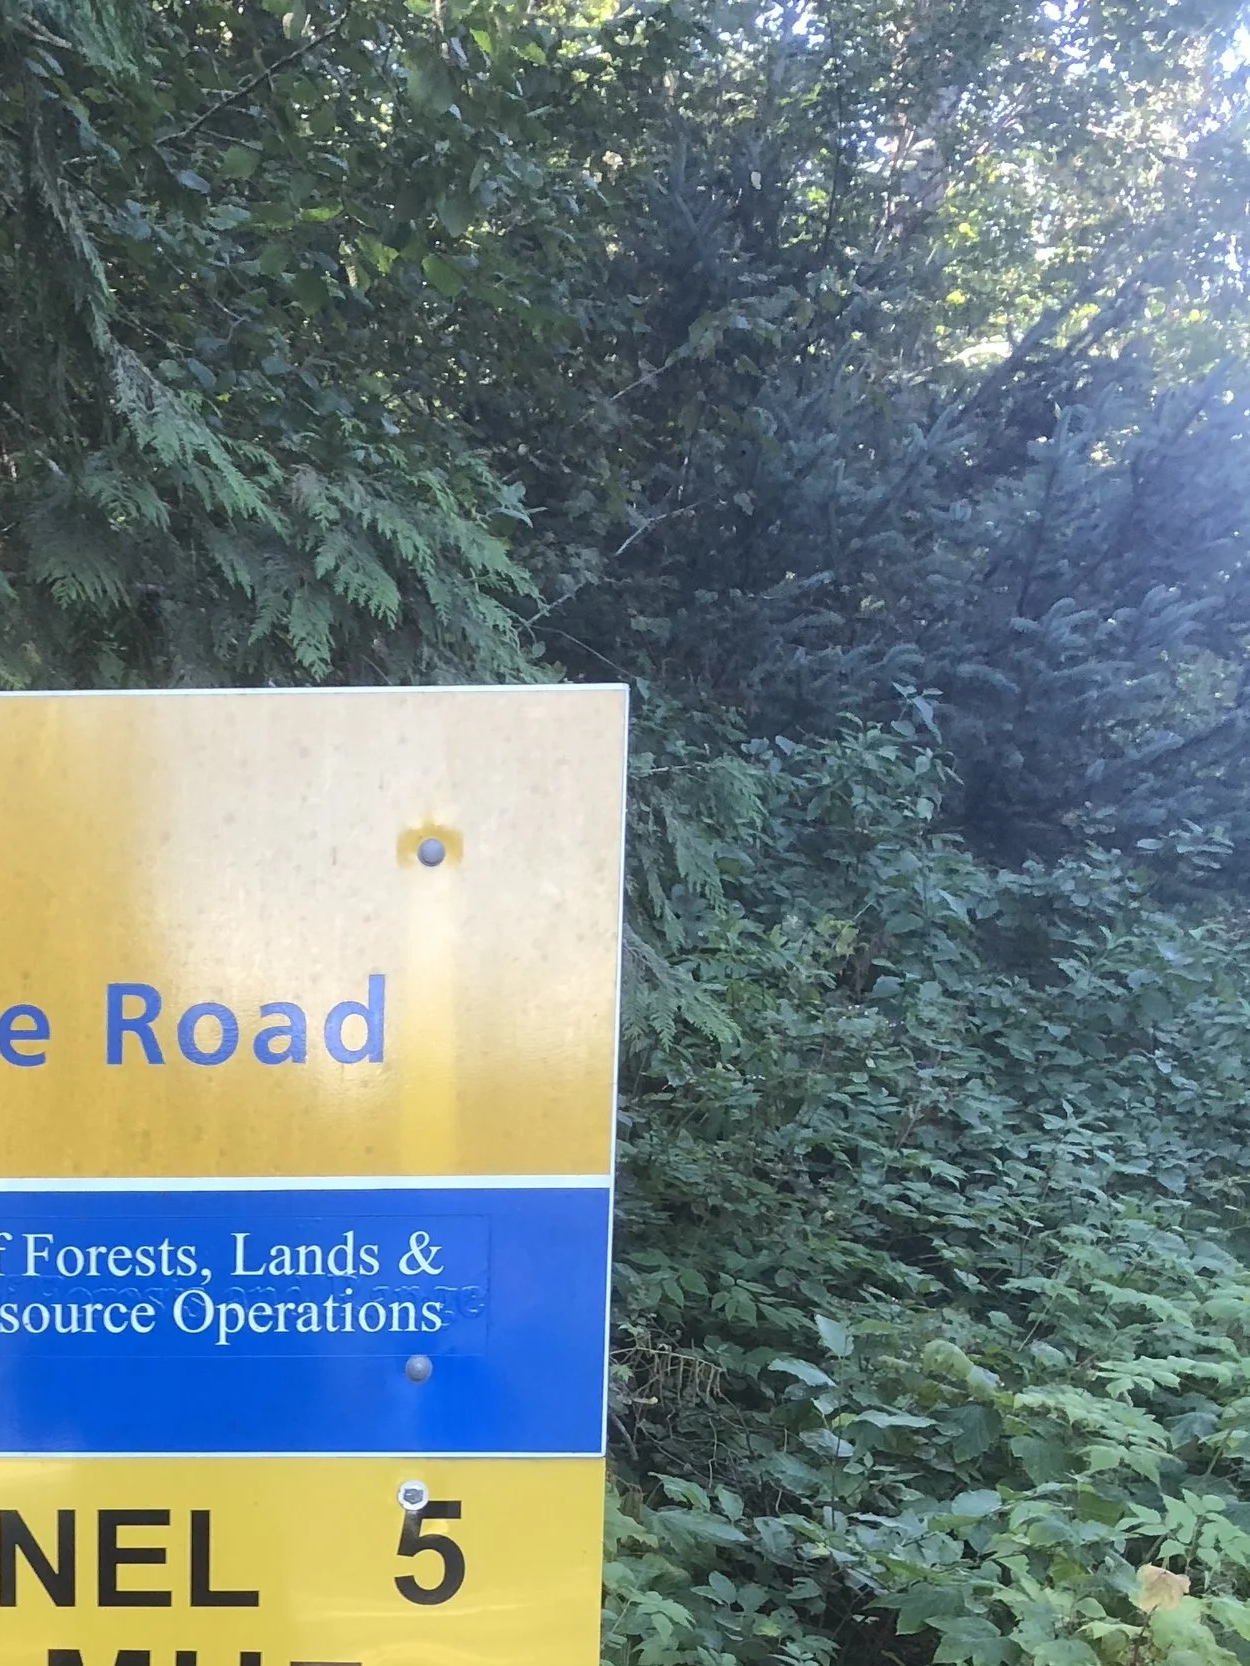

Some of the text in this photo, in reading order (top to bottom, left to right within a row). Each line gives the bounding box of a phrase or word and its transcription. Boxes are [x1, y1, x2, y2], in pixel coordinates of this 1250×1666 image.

[107, 976, 384, 1064] Road
[23, 1233, 212, 1285] Forests,
[232, 1231, 379, 1276] Lands
[399, 1231, 443, 1274] &
[174, 1288, 442, 1345] Operations
[395, 1501, 464, 1604] 5
